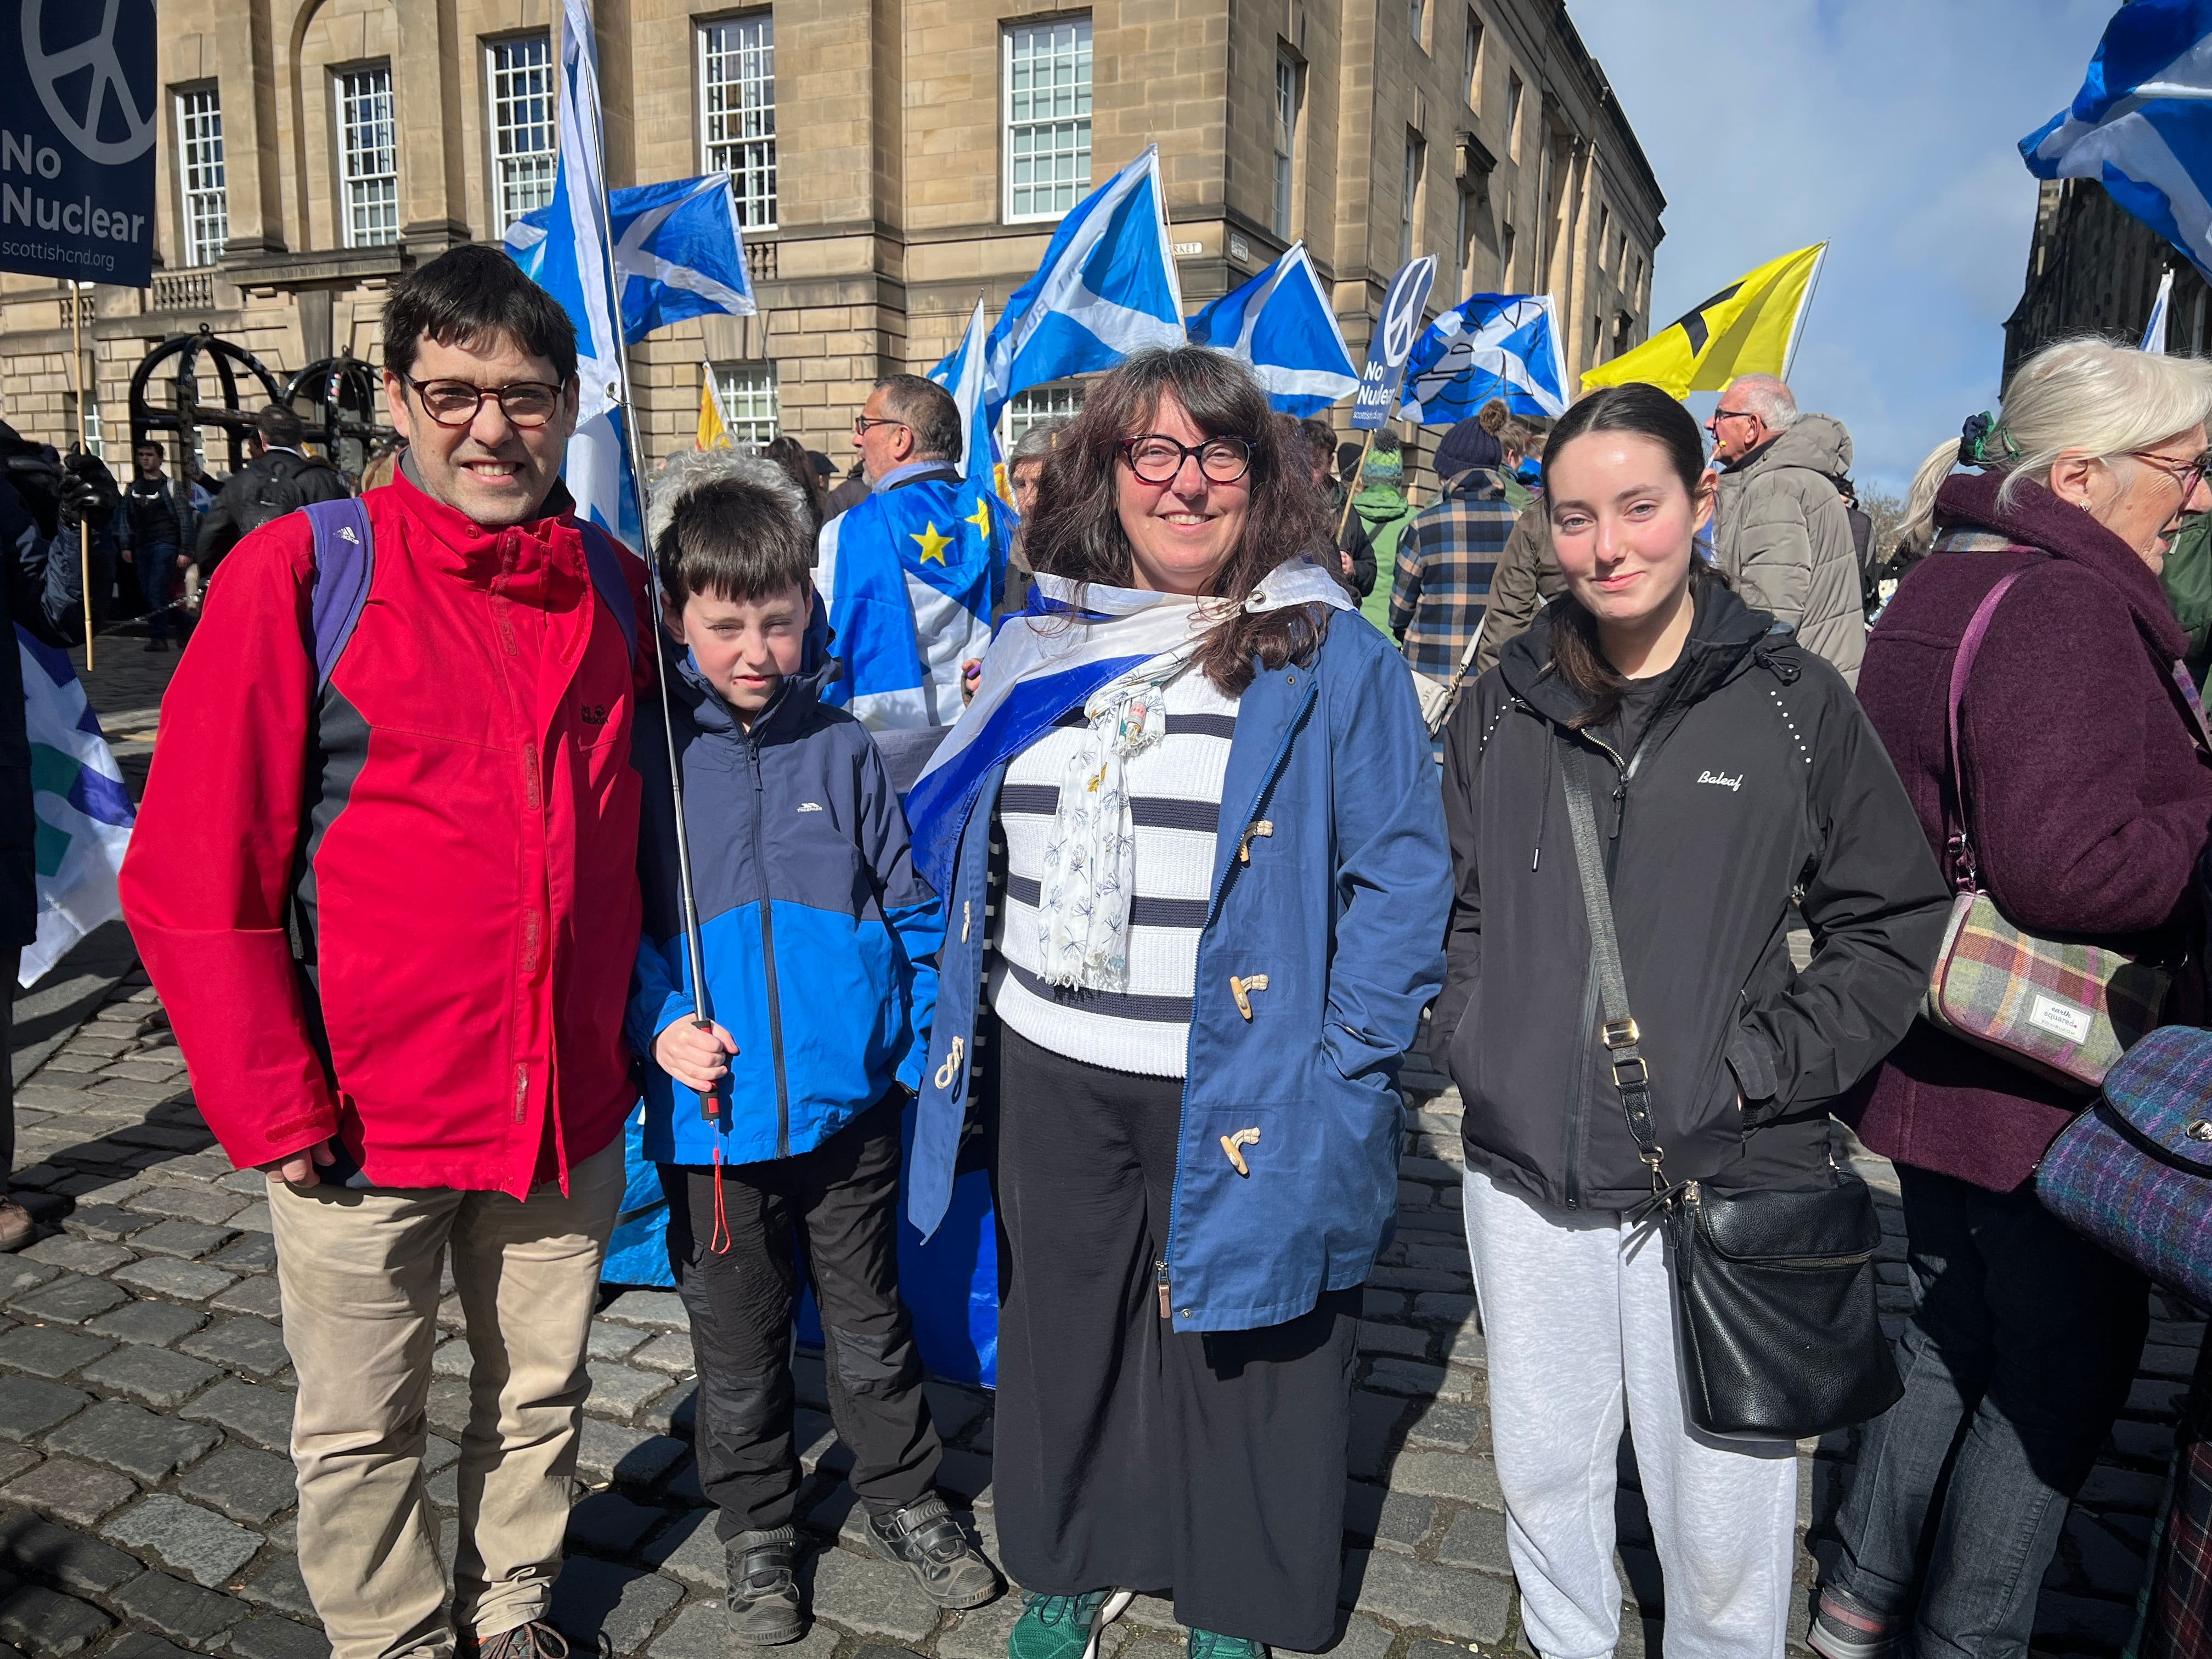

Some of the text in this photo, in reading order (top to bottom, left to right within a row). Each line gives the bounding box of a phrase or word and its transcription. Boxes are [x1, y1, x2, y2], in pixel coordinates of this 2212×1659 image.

[2, 129, 61, 179] No
[3, 183, 145, 243] Nuclear
[2, 241, 114, 272] scottishcnd.org
[1173, 244, 1198, 253] RKET
[1363, 360, 1384, 382] No
[1697, 770, 1743, 792] Baleaf
[2051, 1007, 2071, 1018] earth
